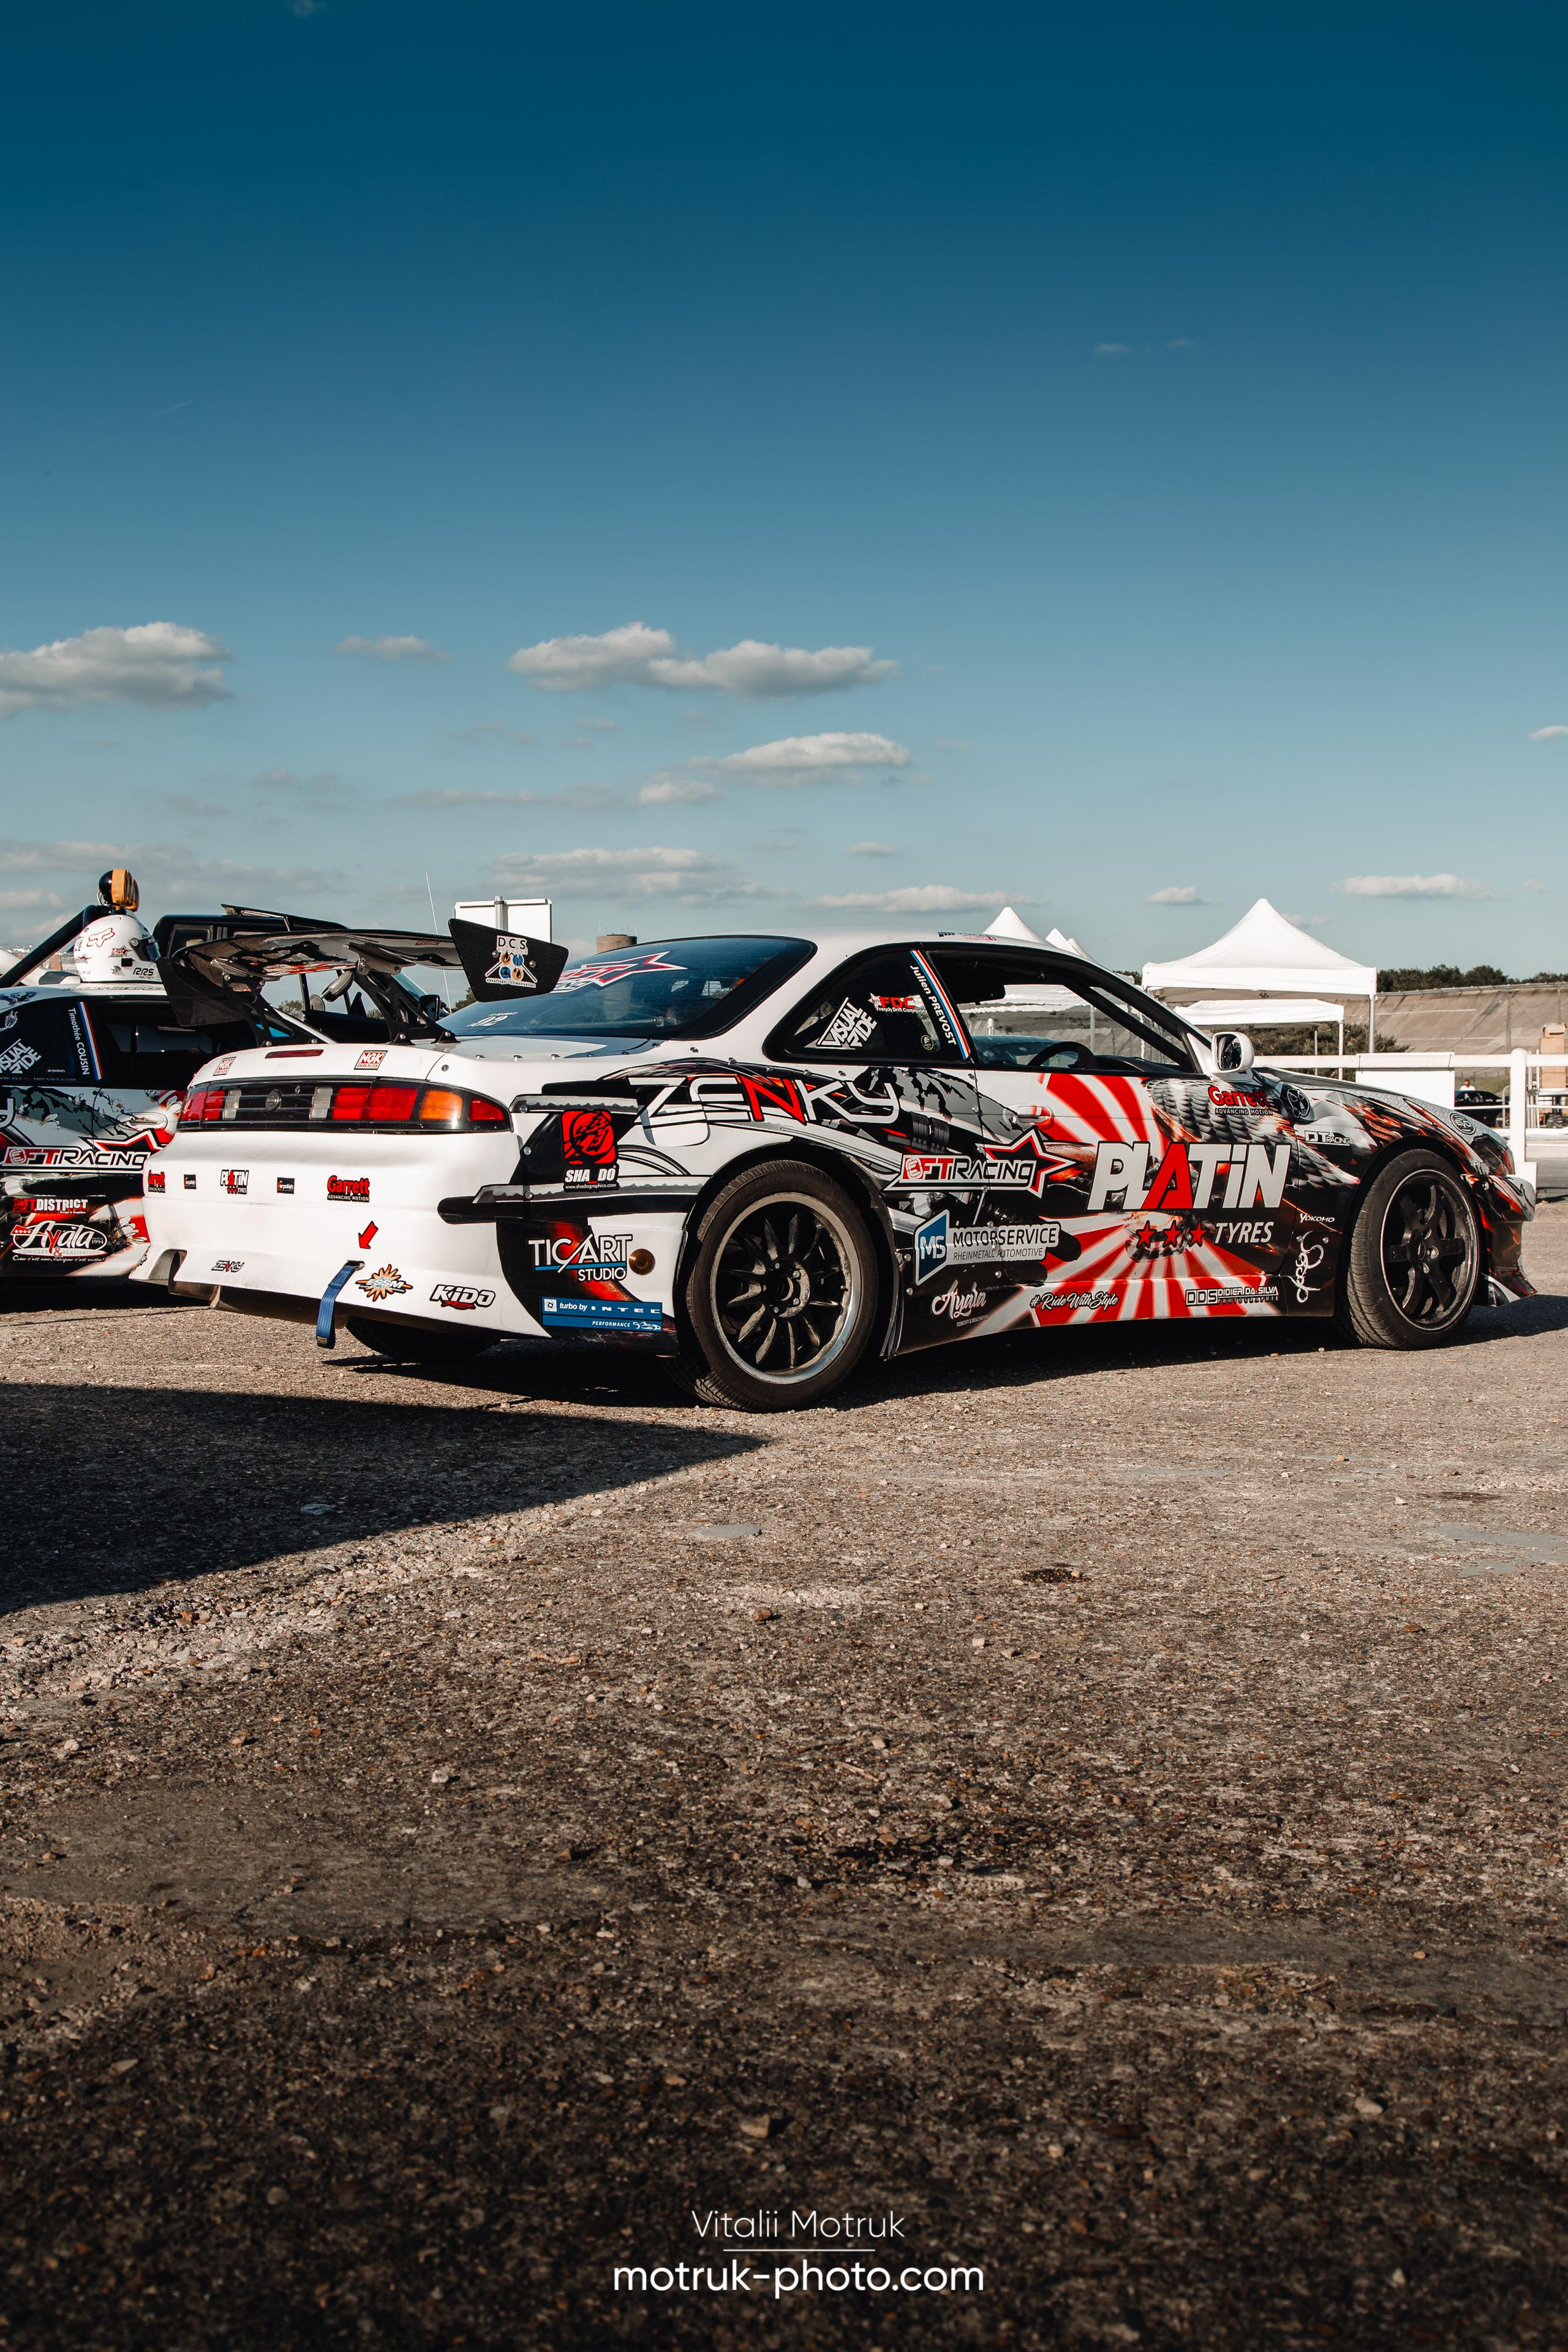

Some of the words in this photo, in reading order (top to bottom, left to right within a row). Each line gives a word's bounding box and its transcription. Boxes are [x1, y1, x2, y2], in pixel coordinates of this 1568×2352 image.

[879, 997, 916, 1009] FDC
[910, 965, 931, 994] Julien
[929, 996, 957, 1045] PREVOST
[69, 1008, 81, 1041] Timothée
[77, 1042, 90, 1075] COUSIN
[216, 1059, 235, 1069] NGK
[359, 1052, 385, 1063] NGK
[1208, 1086, 1270, 1106] Garrett
[328, 1175, 369, 1194] Garrett
[953, 1228, 1057, 1248] MOTORSERVICE
[1215, 1222, 1274, 1243] TYRES
[53, 1246, 62, 1257] &
[921, 1236, 946, 1259] MS
[954, 1250, 995, 1261] RHEINMETALL
[997, 1248, 1042, 1257] AUTOMOTIVE
[366, 1278, 405, 1289] ESSM
[578, 1267, 626, 1281] STUDIO
[932, 1281, 987, 1319] Ayala
[1186, 1289, 1218, 1305] DDS
[1218, 1287, 1243, 1296] DIDIER
[1258, 1286, 1279, 1295] SILVA
[1218, 1295, 1280, 1304] PHOTOGRAPHIE
